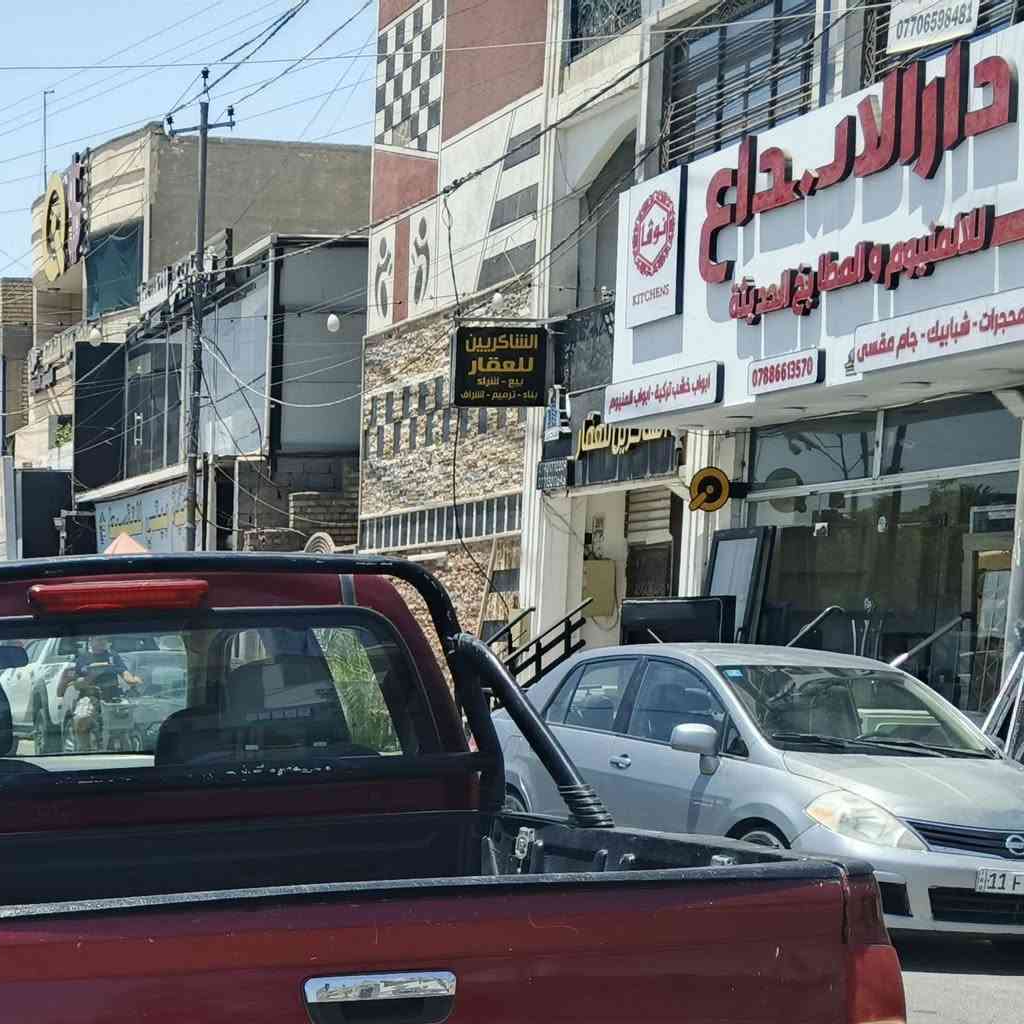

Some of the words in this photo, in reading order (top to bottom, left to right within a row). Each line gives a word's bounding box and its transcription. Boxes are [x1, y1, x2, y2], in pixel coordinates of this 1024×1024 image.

[913, 40, 1017, 179] دار
[699, 59, 926, 283] الابداع
[632, 284, 669, 306] KITCHENS
[896, 326, 918, 359] جام
[927, 310, 970, 347] شبابيك
[468, 357, 534, 375] للعقار
[752, 356, 813, 387] 07886613570
